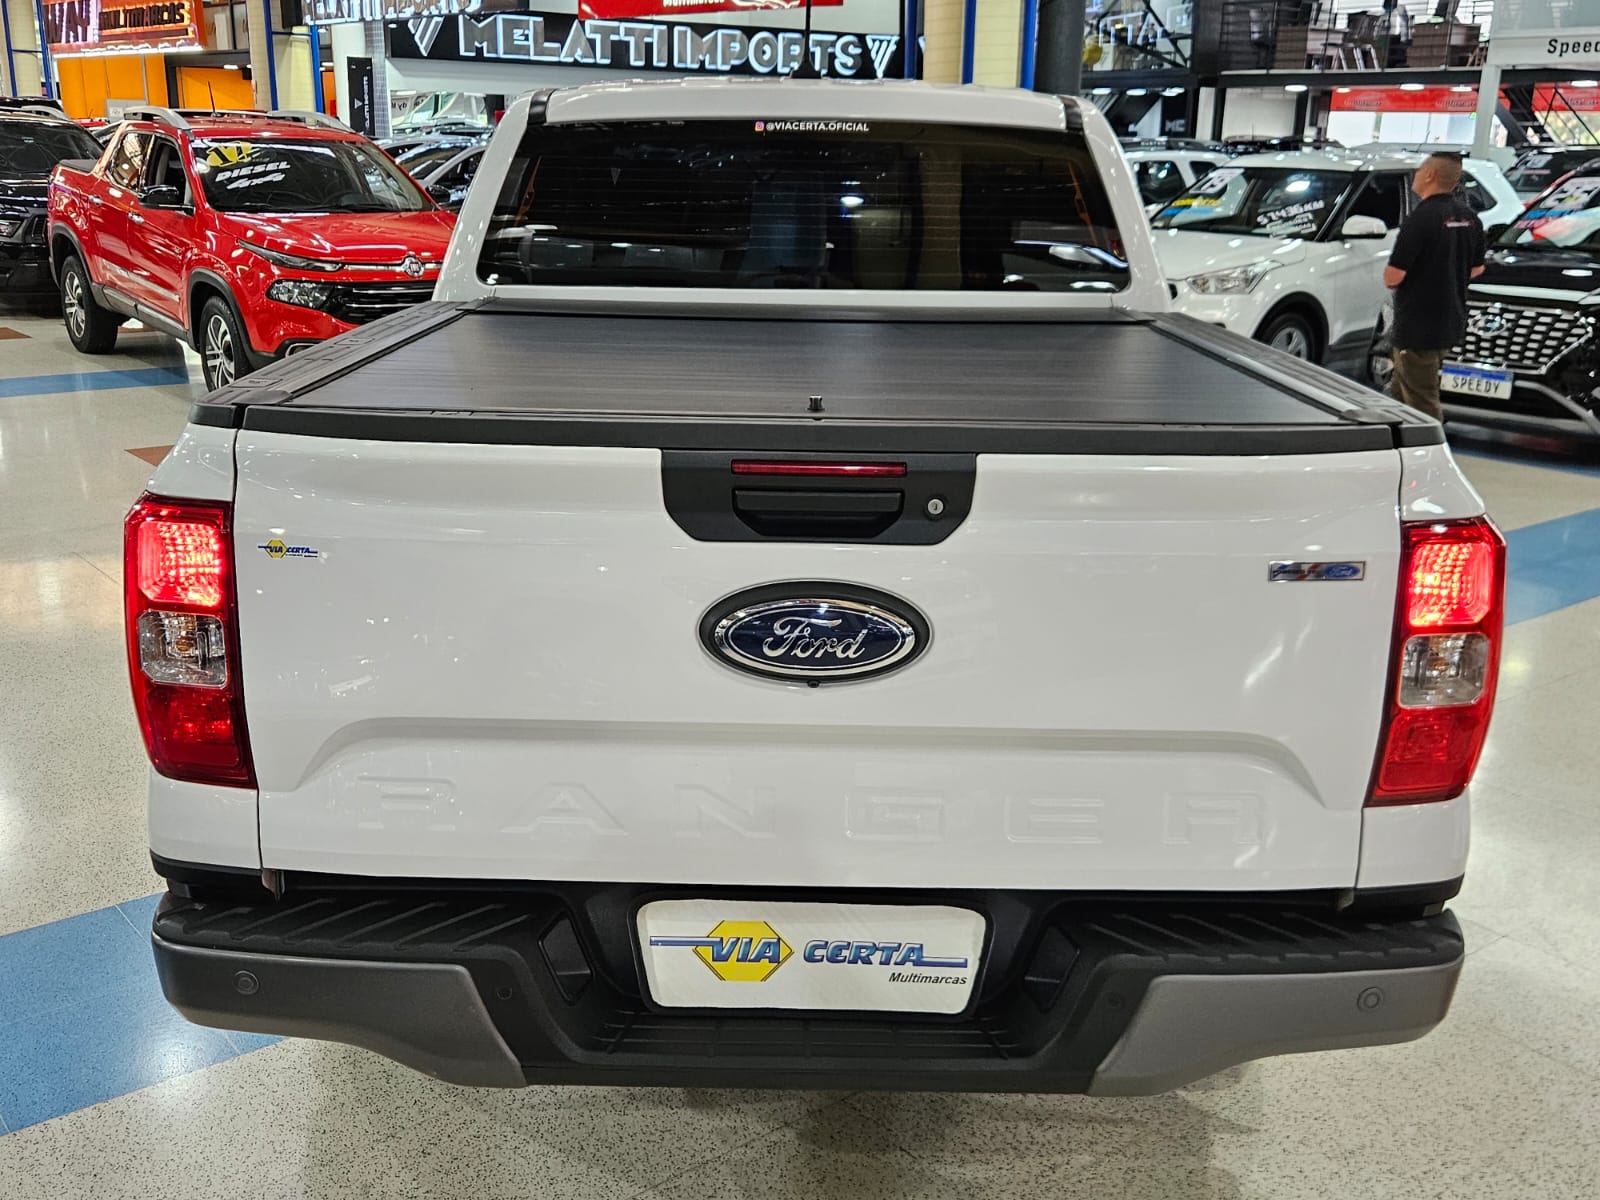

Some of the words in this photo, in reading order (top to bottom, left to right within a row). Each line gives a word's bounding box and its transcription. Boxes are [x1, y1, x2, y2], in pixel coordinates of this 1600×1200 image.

[459, 14, 669, 67] MELATTI
[673, 26, 863, 76] IMPORTS
[766, 121, 870, 132] @VIACERTA.OFICIAL
[215, 161, 291, 182] DIESEL
[1452, 375, 1501, 394] SPEEDY
[763, 616, 868, 660] Ford
[357, 776, 1263, 846] RANGER
[711, 936, 781, 964] VIA
[803, 938, 926, 967] CERTA
[888, 971, 968, 986] Multimarcas
